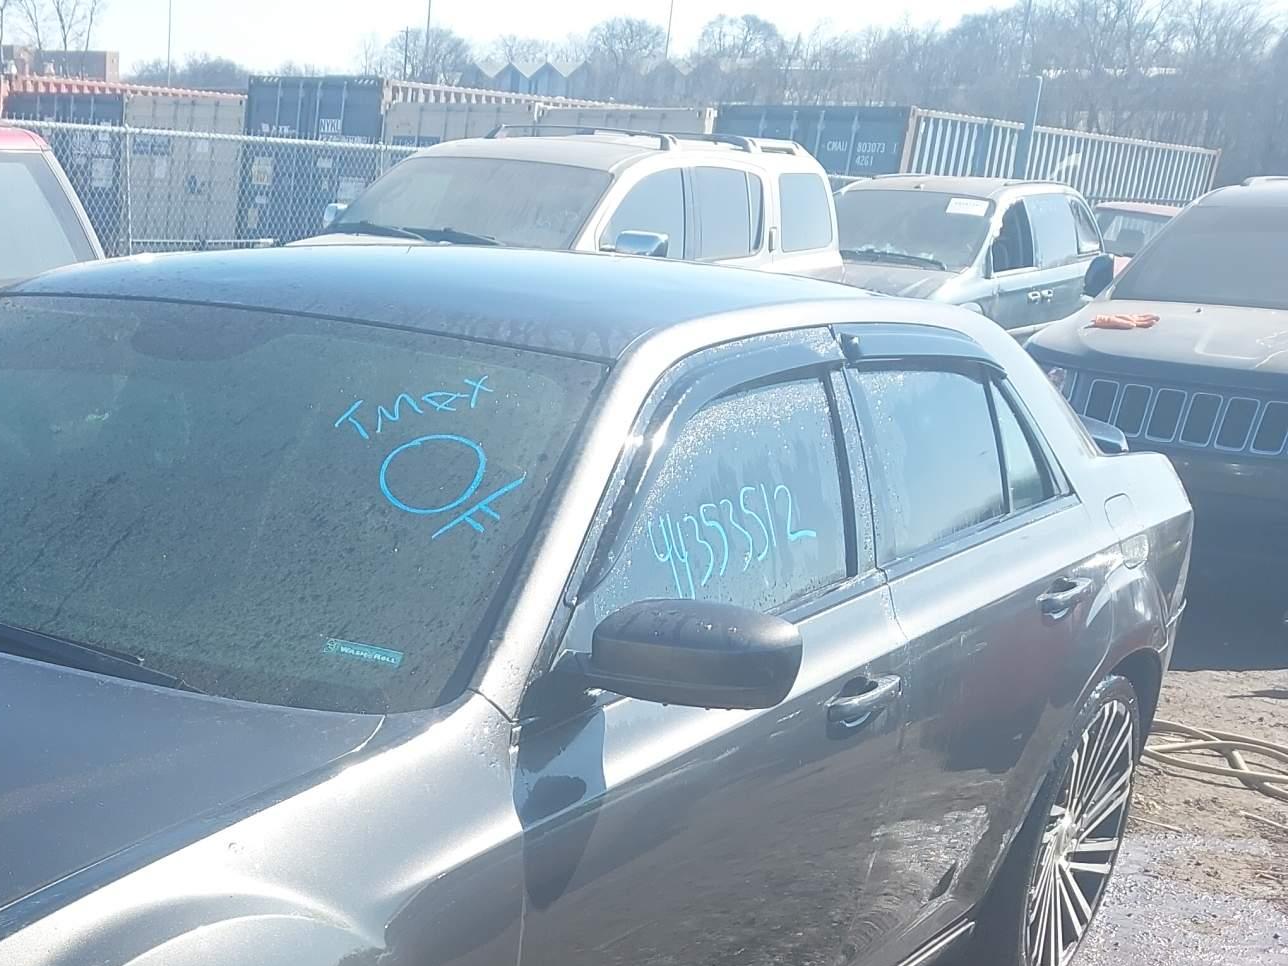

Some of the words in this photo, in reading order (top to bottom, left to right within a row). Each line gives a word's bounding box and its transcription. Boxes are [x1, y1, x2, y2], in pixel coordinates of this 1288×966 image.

[826, 140, 848, 152] CMAU
[334, 374, 495, 440] TMAX
[647, 483, 817, 601] 44353512
